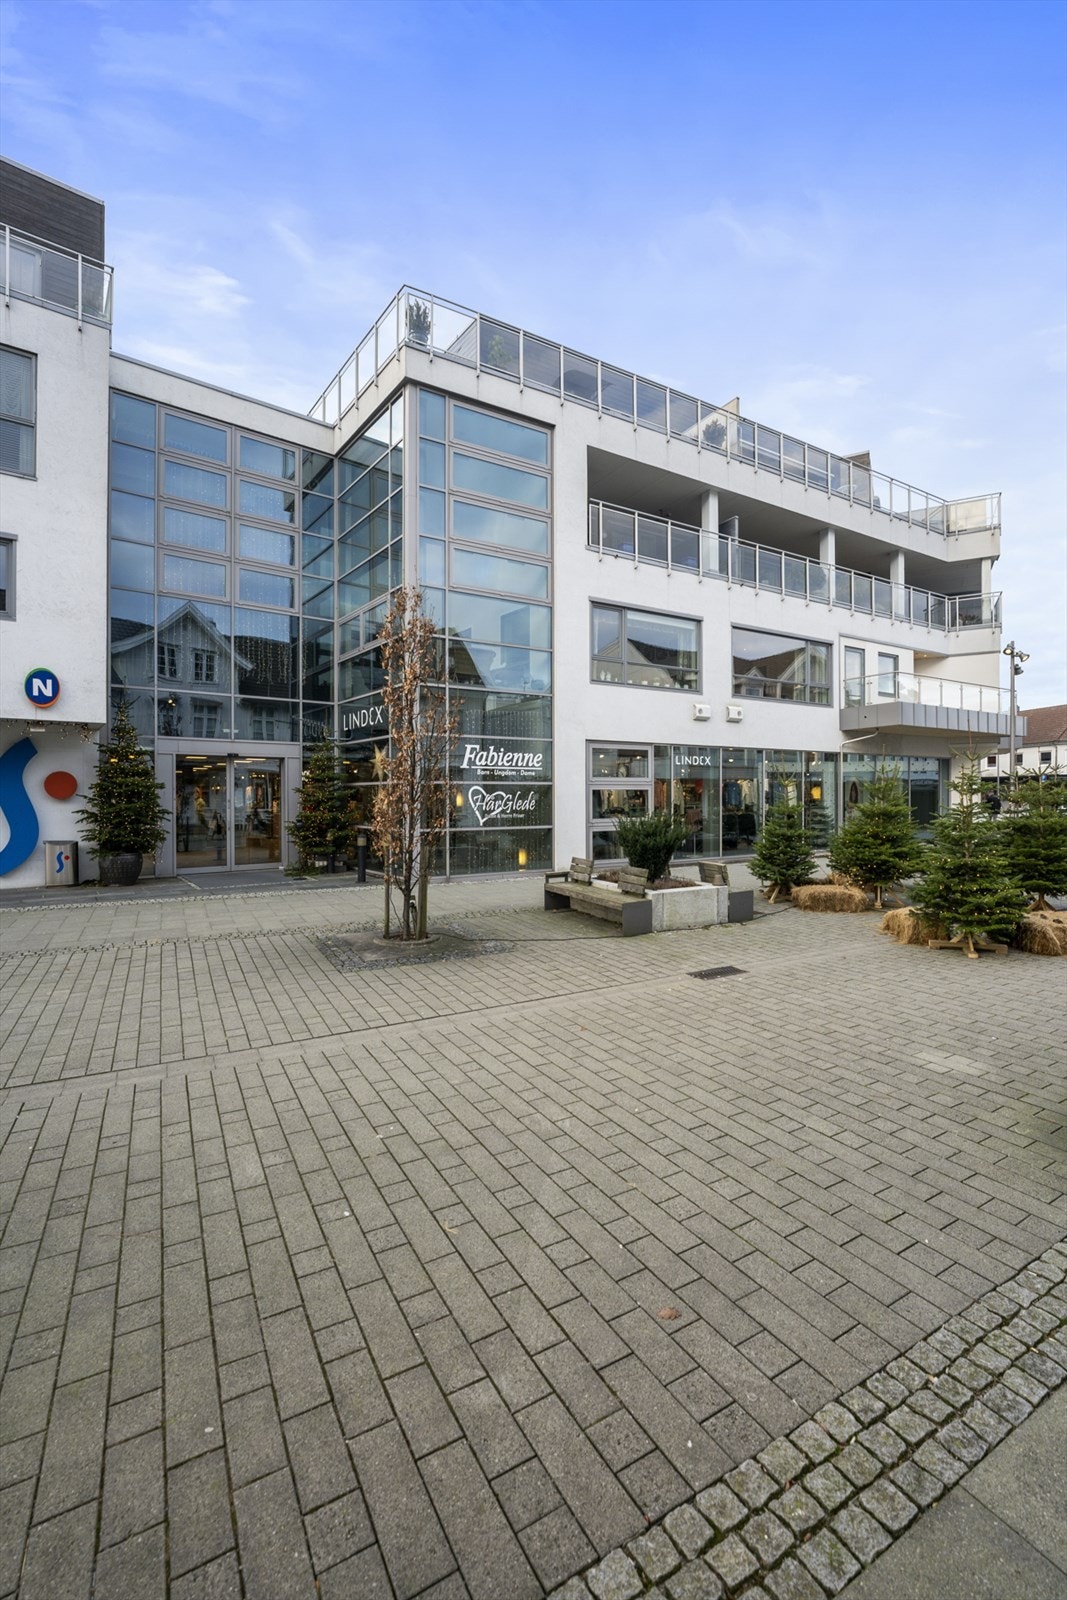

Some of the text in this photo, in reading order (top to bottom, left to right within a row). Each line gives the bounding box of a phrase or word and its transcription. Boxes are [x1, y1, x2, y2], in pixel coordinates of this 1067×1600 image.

[32, 677, 53, 697] N
[343, 704, 383, 731] LINDEX
[460, 744, 543, 769] Fabienne
[675, 755, 711, 766] LINDEX
[494, 769, 517, 777] Ungdom
